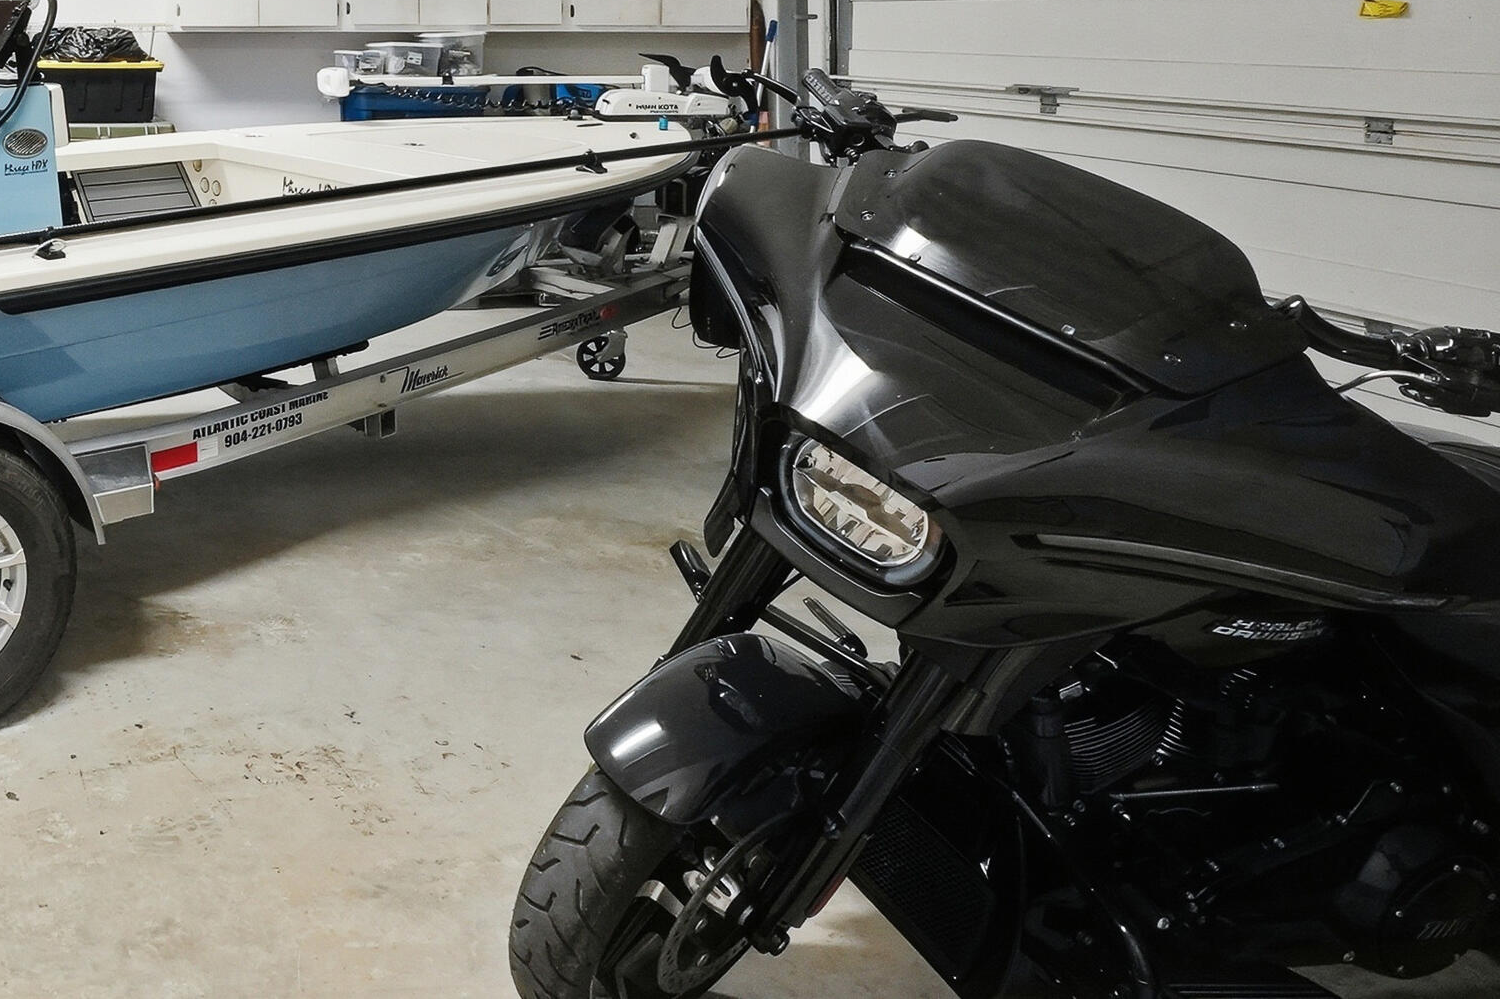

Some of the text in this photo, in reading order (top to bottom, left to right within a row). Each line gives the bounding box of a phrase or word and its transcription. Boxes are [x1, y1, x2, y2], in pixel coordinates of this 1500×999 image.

[401, 365, 449, 394] Maverick
[192, 391, 330, 441] ATLANTIC COAST MARINE
[224, 412, 303, 448] 904-221-0793
